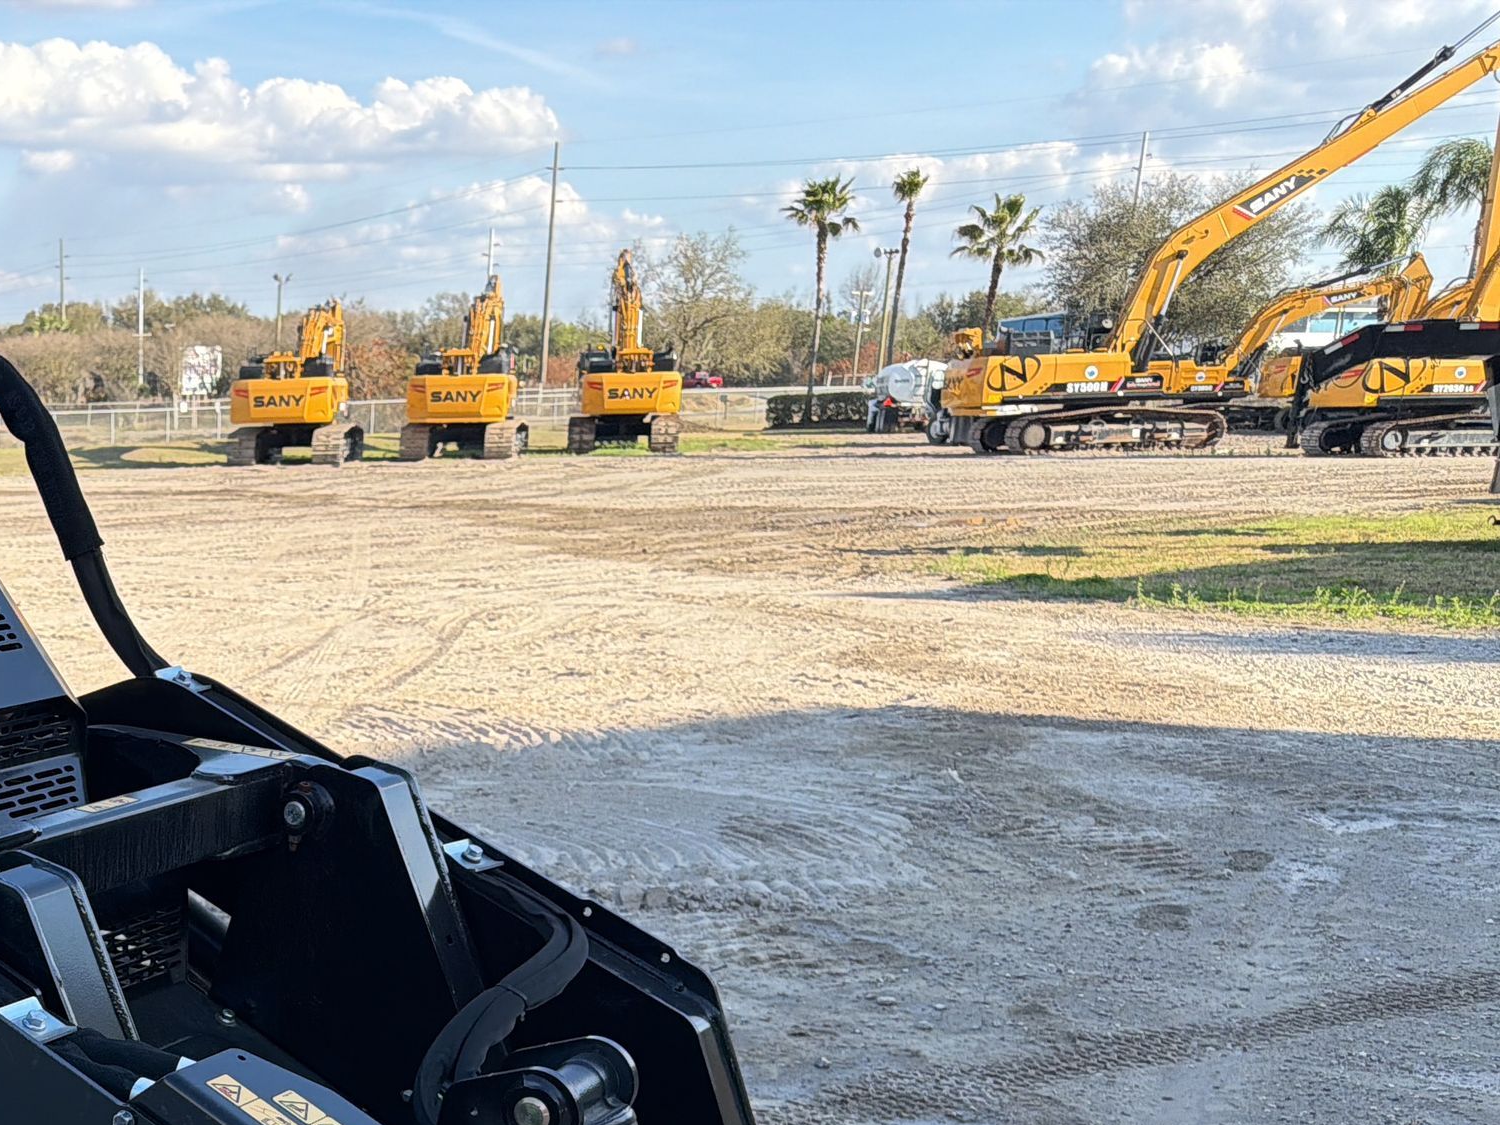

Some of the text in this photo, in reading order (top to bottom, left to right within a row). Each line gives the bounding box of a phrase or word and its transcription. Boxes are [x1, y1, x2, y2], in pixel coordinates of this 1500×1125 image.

[1249, 175, 1297, 213] SANY
[1330, 293, 1358, 303] SANY
[430, 390, 482, 403] SANY
[608, 387, 658, 400] SANY
[252, 394, 305, 408] SANY
